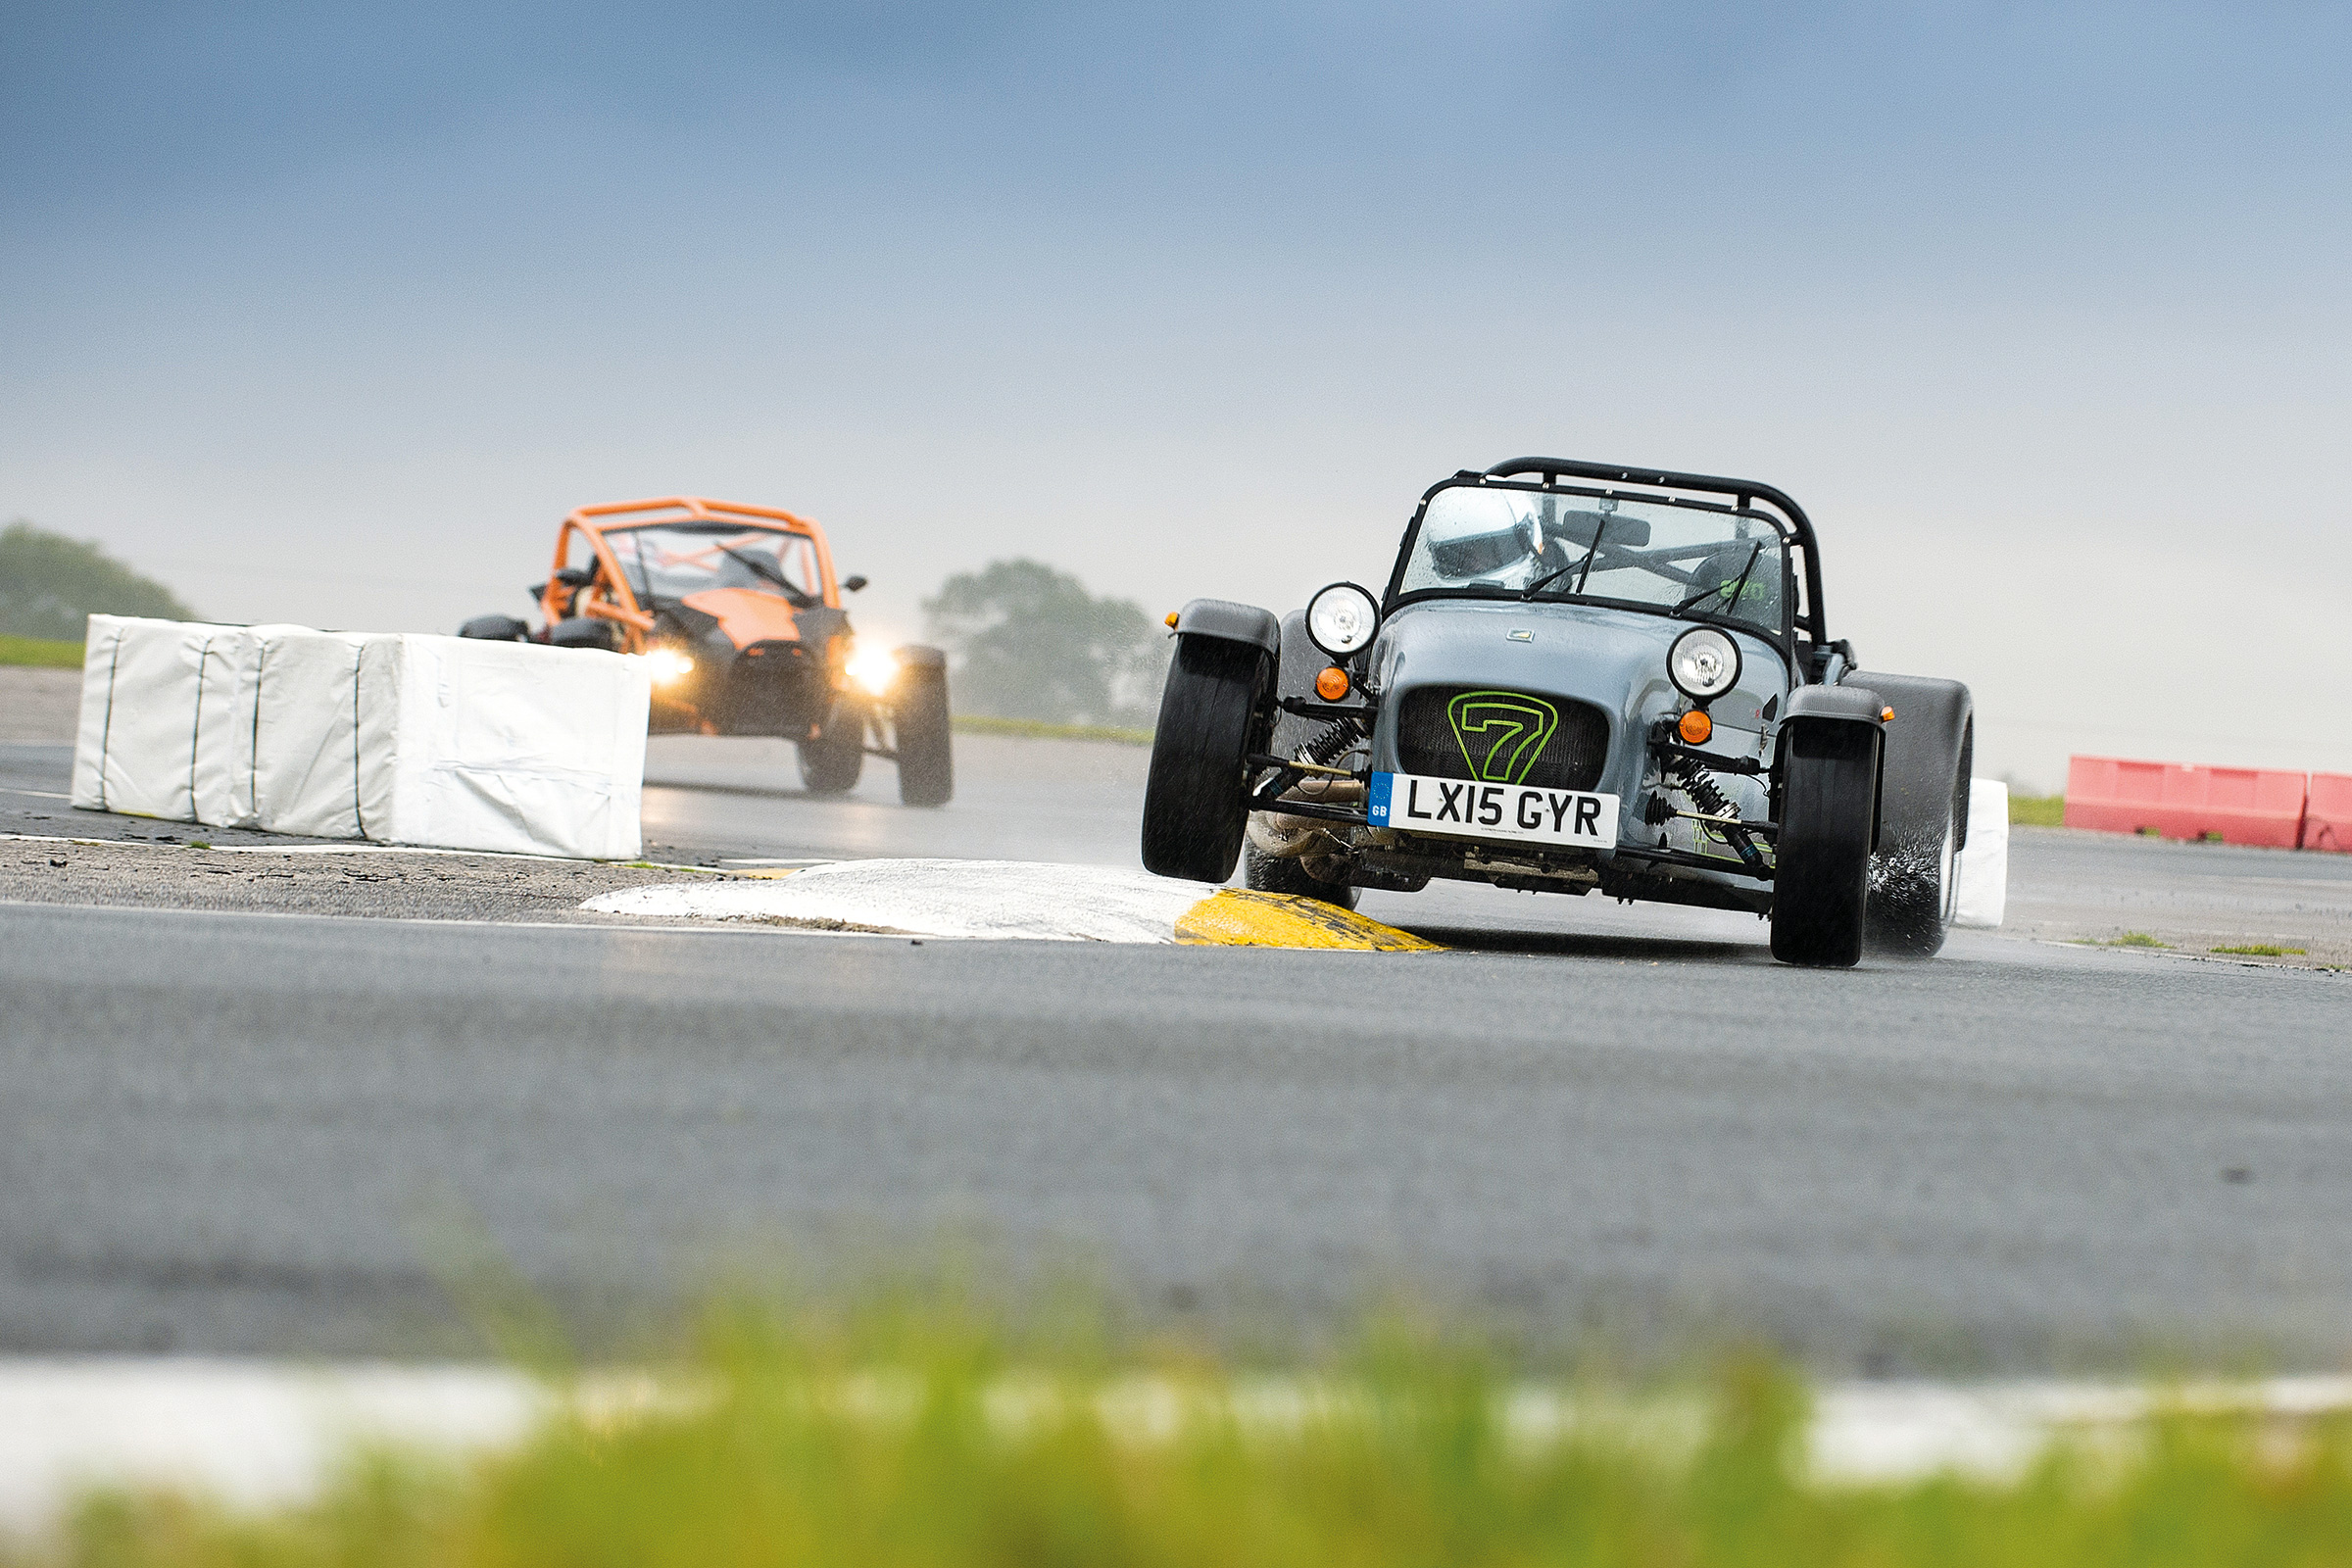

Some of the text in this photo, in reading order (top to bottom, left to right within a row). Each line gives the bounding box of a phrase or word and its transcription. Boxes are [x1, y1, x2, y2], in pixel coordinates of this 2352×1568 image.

[1461, 703, 1544, 781] 7
[1372, 805, 1387, 816] GB
[1407, 779, 1601, 836] LX15 GYR
